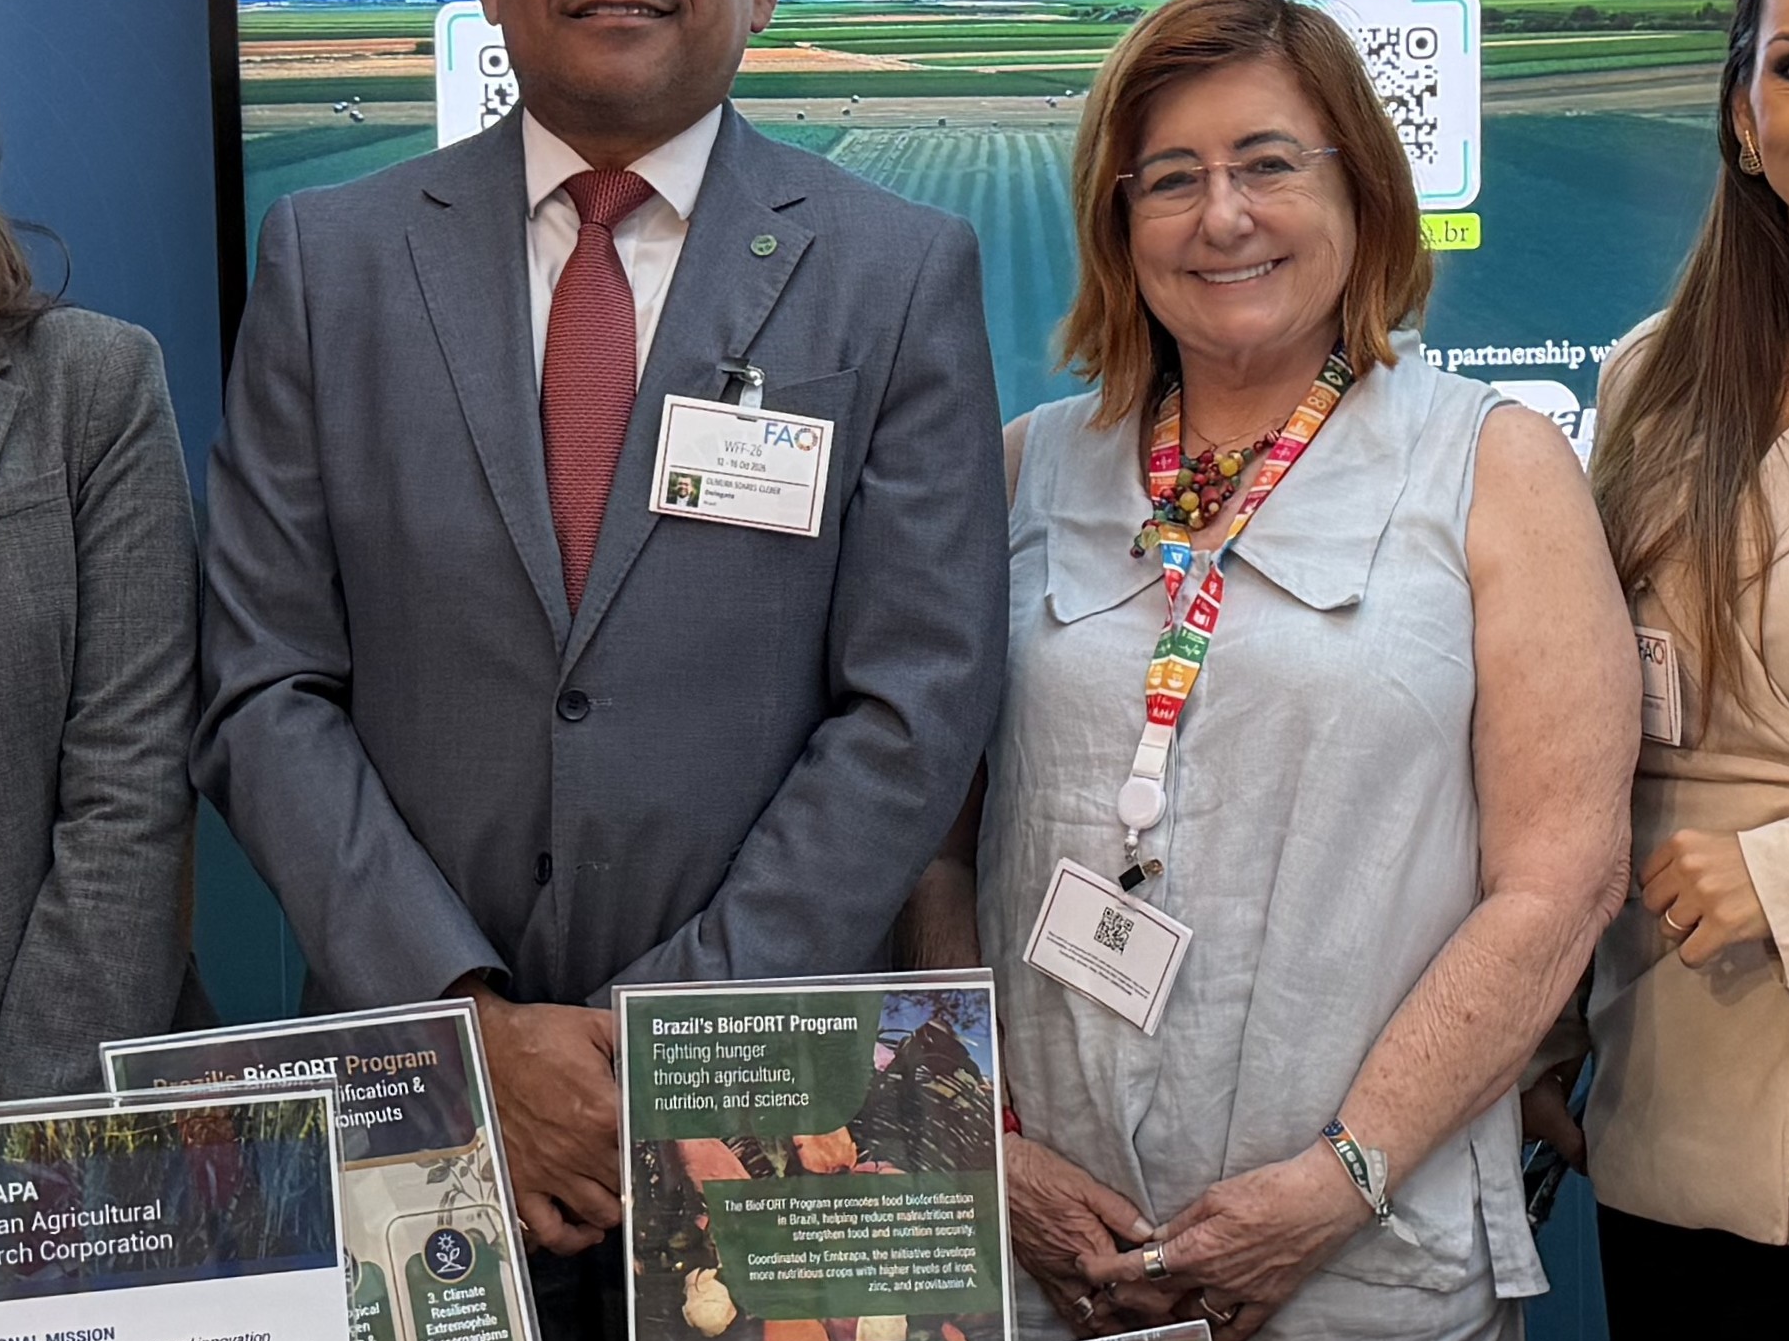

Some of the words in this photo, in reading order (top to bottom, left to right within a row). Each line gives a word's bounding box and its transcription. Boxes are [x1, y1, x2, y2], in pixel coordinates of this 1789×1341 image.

[1447, 339, 1585, 372] partnership
[724, 440, 763, 458] WFF-26
[652, 1017, 713, 1035] Brazil's
[718, 1015, 786, 1034] BioFORT
[790, 1014, 858, 1034] Program
[345, 1050, 437, 1076] Program
[653, 1043, 711, 1063] Fighting
[715, 1042, 766, 1062] hunger
[654, 1067, 710, 1087] through
[714, 1067, 796, 1085] agriculture,
[655, 1092, 718, 1111] nutrition,
[723, 1091, 750, 1109] and
[755, 1091, 810, 1107] science
[32, 1200, 162, 1235] Agricultural
[40, 1232, 173, 1265] Corporation
[428, 1291, 439, 1304] 3.
[444, 1285, 486, 1302] Climate
[431, 1299, 487, 1320] Resilience
[426, 1315, 498, 1337] Extremophile
